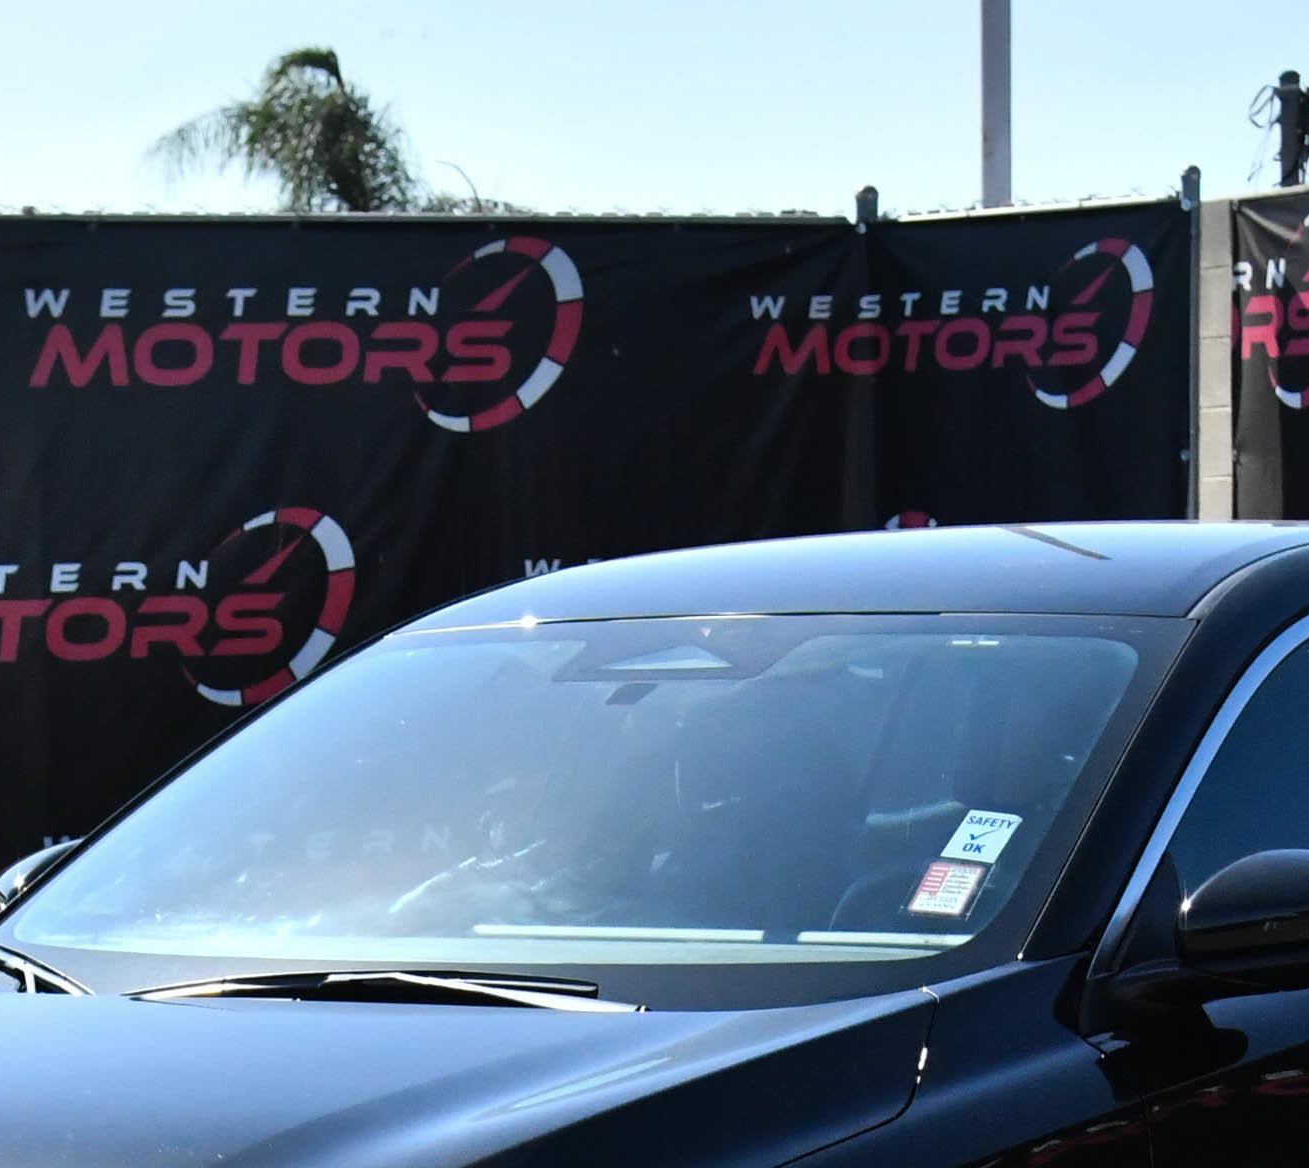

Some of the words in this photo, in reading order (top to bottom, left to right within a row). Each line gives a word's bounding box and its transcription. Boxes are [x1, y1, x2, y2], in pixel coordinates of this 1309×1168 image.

[24, 287, 440, 318] WESTERN
[749, 285, 1051, 320] WESTERN
[30, 319, 514, 388] MOTORS
[753, 311, 1101, 375] MOTORS
[966, 815, 1016, 829] SAFETY
[962, 842, 986, 854] OK
